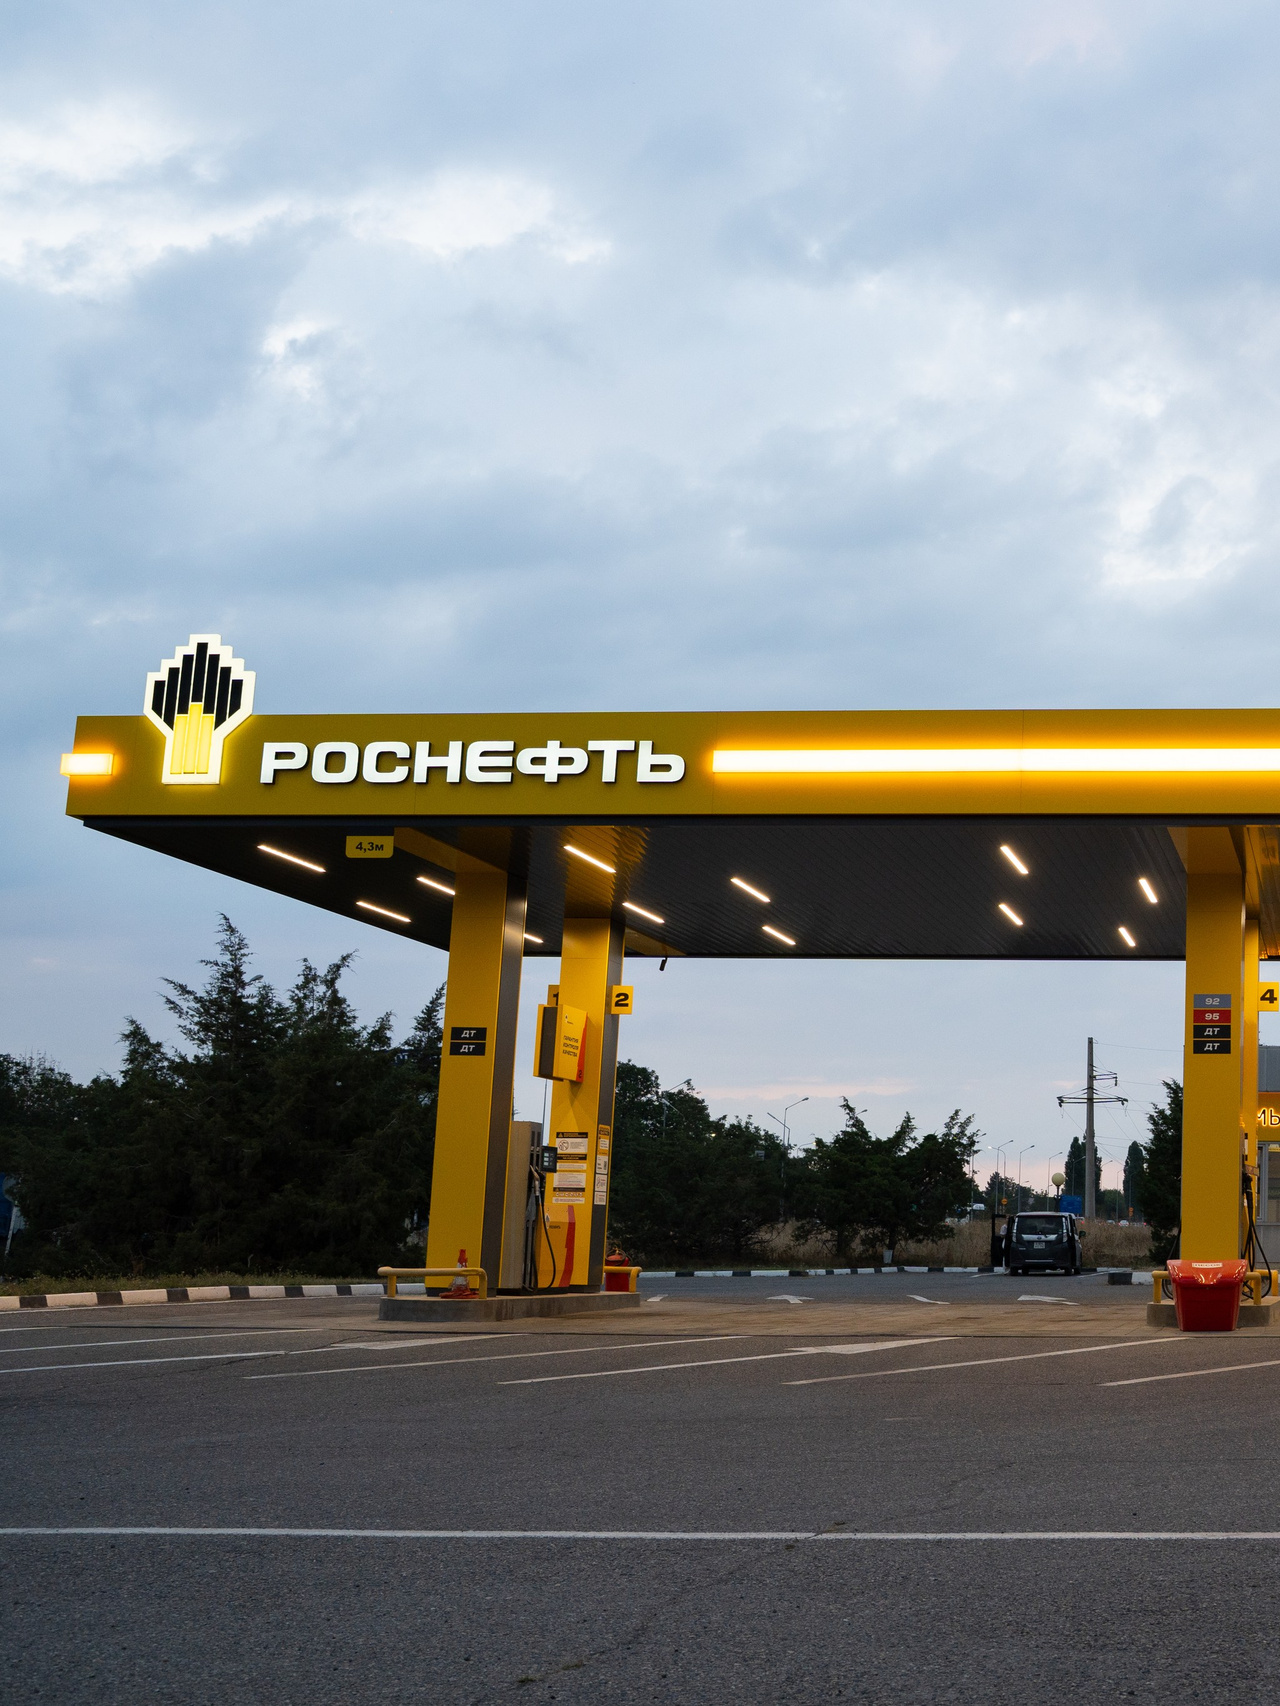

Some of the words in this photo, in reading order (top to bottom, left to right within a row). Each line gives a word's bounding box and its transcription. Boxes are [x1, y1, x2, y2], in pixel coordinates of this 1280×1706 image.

[260, 739, 686, 785] РОСНЕФТЬ
[355, 841, 384, 854] 4,3м
[552, 992, 559, 1006] 1
[614, 992, 629, 1007] 2
[1260, 988, 1278, 1004] 4
[1204, 997, 1220, 1005] 92
[1204, 1012, 1220, 1020] 95
[460, 1030, 477, 1038] ДТ
[1203, 1027, 1220, 1036] ДТ
[459, 1044, 476, 1053] ДТ
[1203, 1043, 1220, 1051] ДТ
